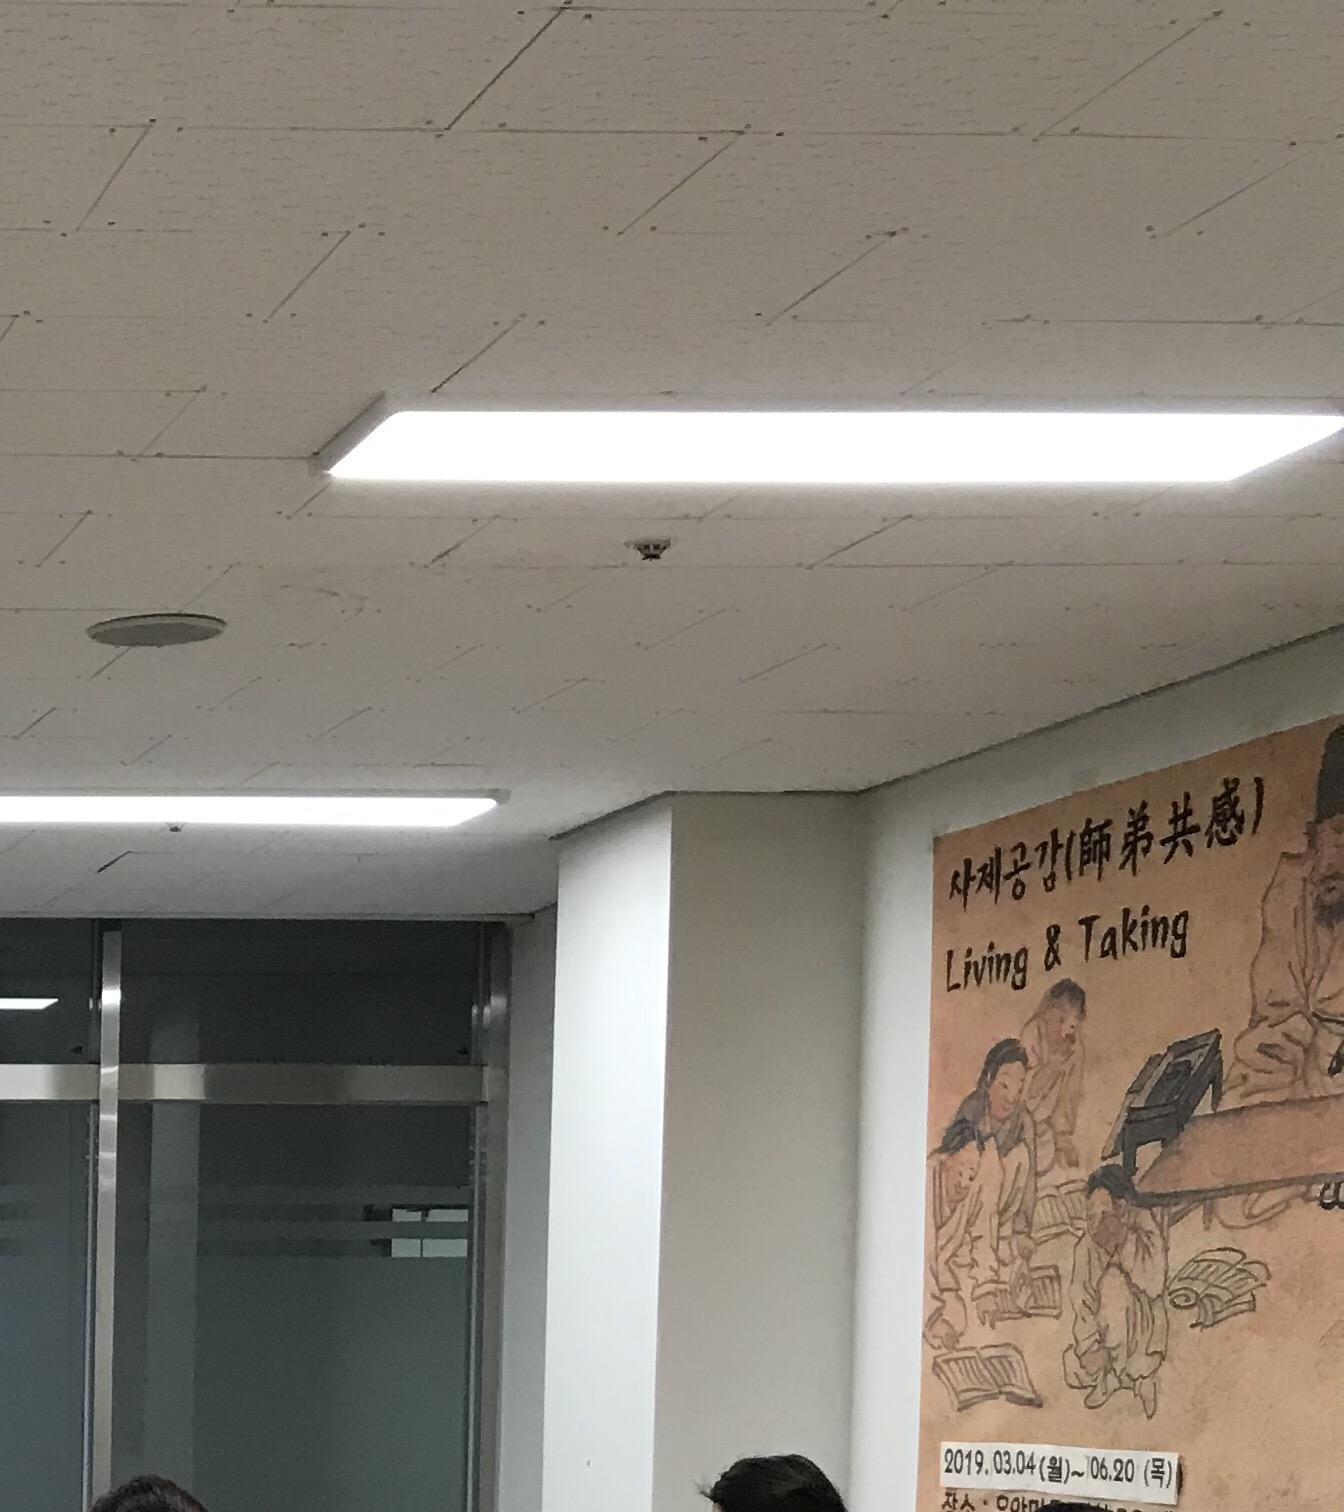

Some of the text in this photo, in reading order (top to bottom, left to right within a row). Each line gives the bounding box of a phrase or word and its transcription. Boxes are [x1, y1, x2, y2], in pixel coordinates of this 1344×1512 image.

[946, 904, 1190, 992] Living & Taking
